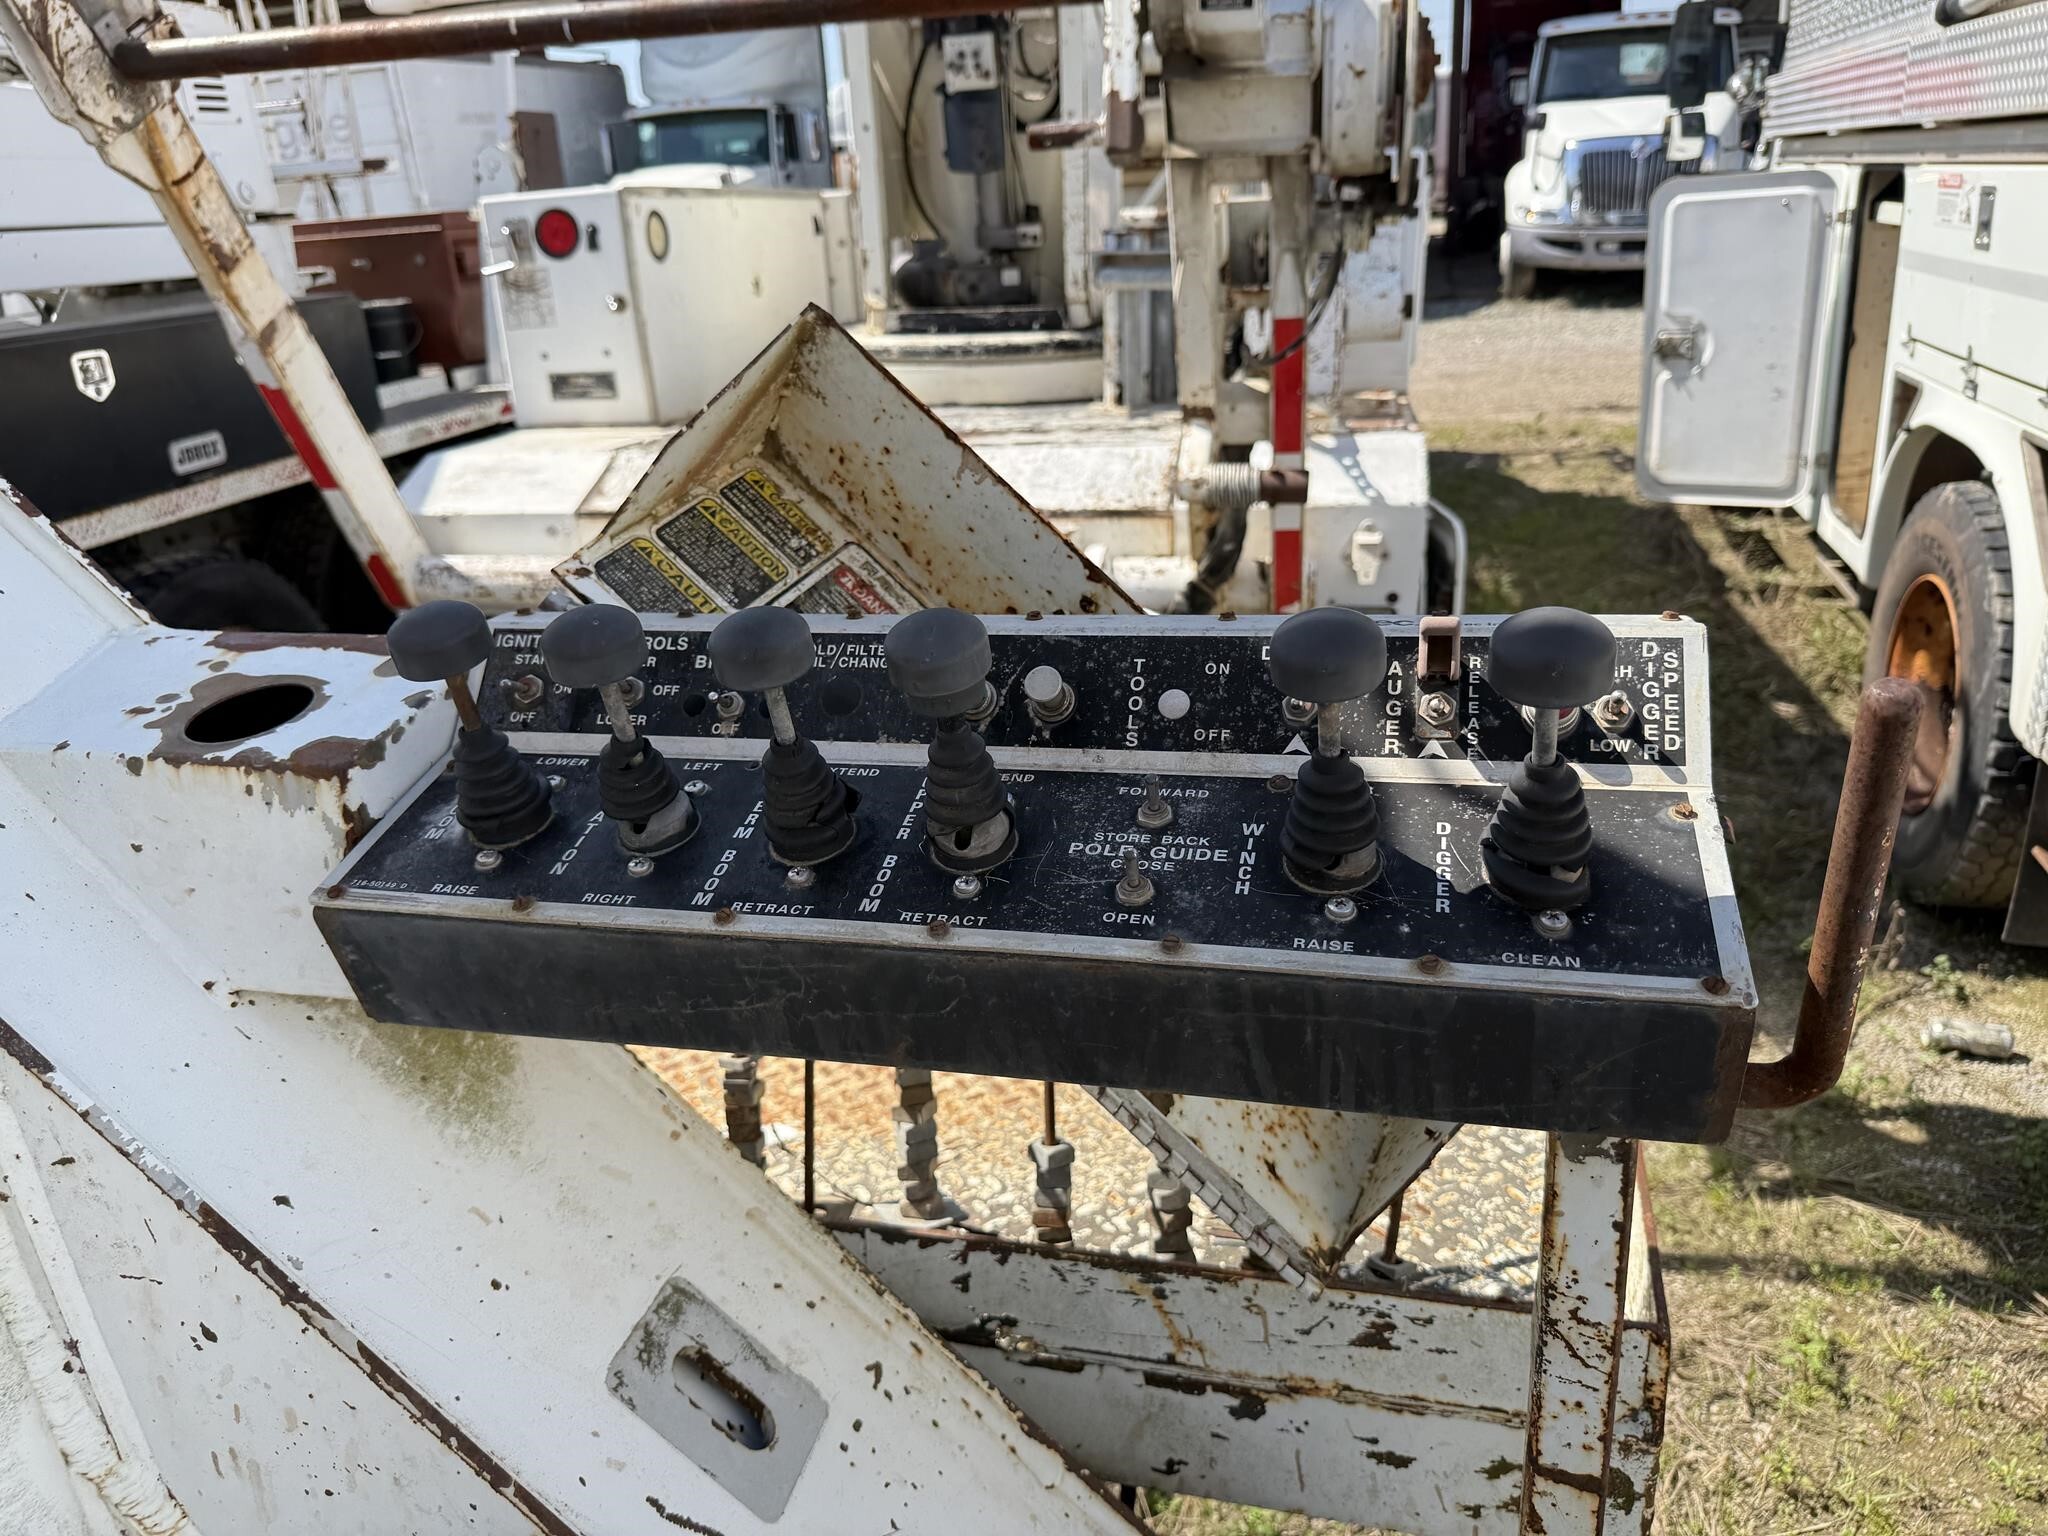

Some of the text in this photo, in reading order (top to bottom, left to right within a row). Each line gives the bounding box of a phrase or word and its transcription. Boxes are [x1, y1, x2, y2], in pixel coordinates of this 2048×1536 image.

[719, 517, 786, 578] CAUTION
[496, 634, 541, 648] IGNIT
[1204, 662, 1231, 675] ON
[652, 685, 681, 697] OFF
[1125, 658, 1146, 747] TOOLS
[1384, 660, 1403, 754] AUGER
[1466, 656, 1482, 761] RELEASE
[1641, 641, 1661, 761] DIGGER
[1662, 651, 1681, 752] SPEED
[509, 711, 537, 723] OFF
[1193, 728, 1231, 742] OFF
[1589, 738, 1631, 753] LOW
[535, 756, 590, 767] LOWER
[683, 762, 724, 772] LEFT
[830, 767, 881, 777] XTEND
[1118, 786, 1210, 798] FOWARD
[549, 810, 605, 876] ATION
[858, 777, 928, 913] PPER BOOM
[1093, 832, 1211, 847] STORE BACK
[1149, 846, 1229, 862] GUIDE
[1234, 823, 1265, 896] WINCH
[1110, 859, 1175, 871] COSE
[1435, 821, 1451, 914] DIGGER
[690, 849, 737, 906] BOOM
[429, 883, 480, 896] RAISE
[581, 893, 636, 905] RIGHT
[730, 901, 815, 916] RETRACT
[899, 911, 988, 927] RETRACT
[1102, 912, 1155, 925] OPEN
[1292, 937, 1355, 952] RAISE
[1501, 952, 1582, 969] CLEAN
